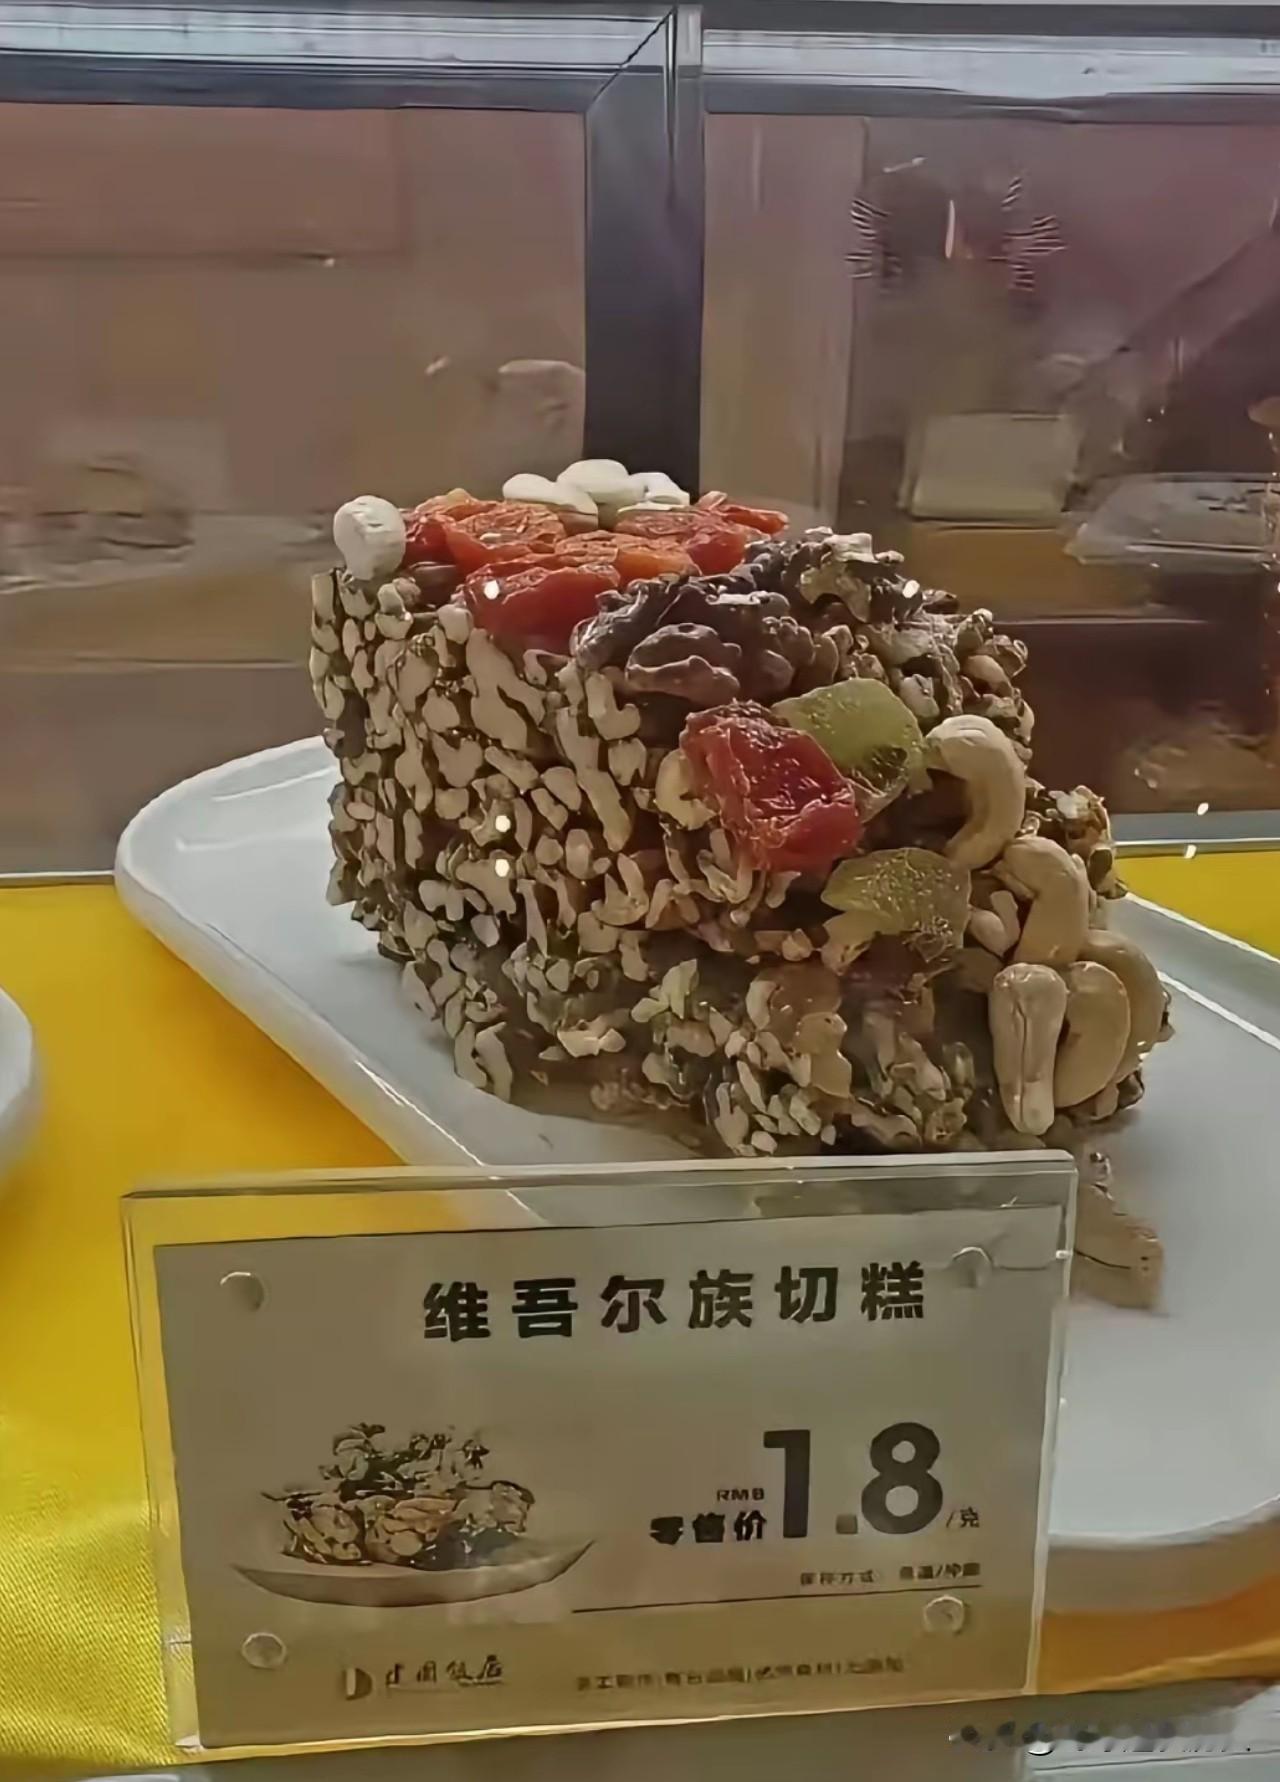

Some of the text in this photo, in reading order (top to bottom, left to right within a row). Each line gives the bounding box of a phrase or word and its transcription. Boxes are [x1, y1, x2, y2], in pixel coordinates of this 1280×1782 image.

[422, 1261, 926, 1343] 维吾尔族切糕
[716, 1487, 766, 1503] RMB
